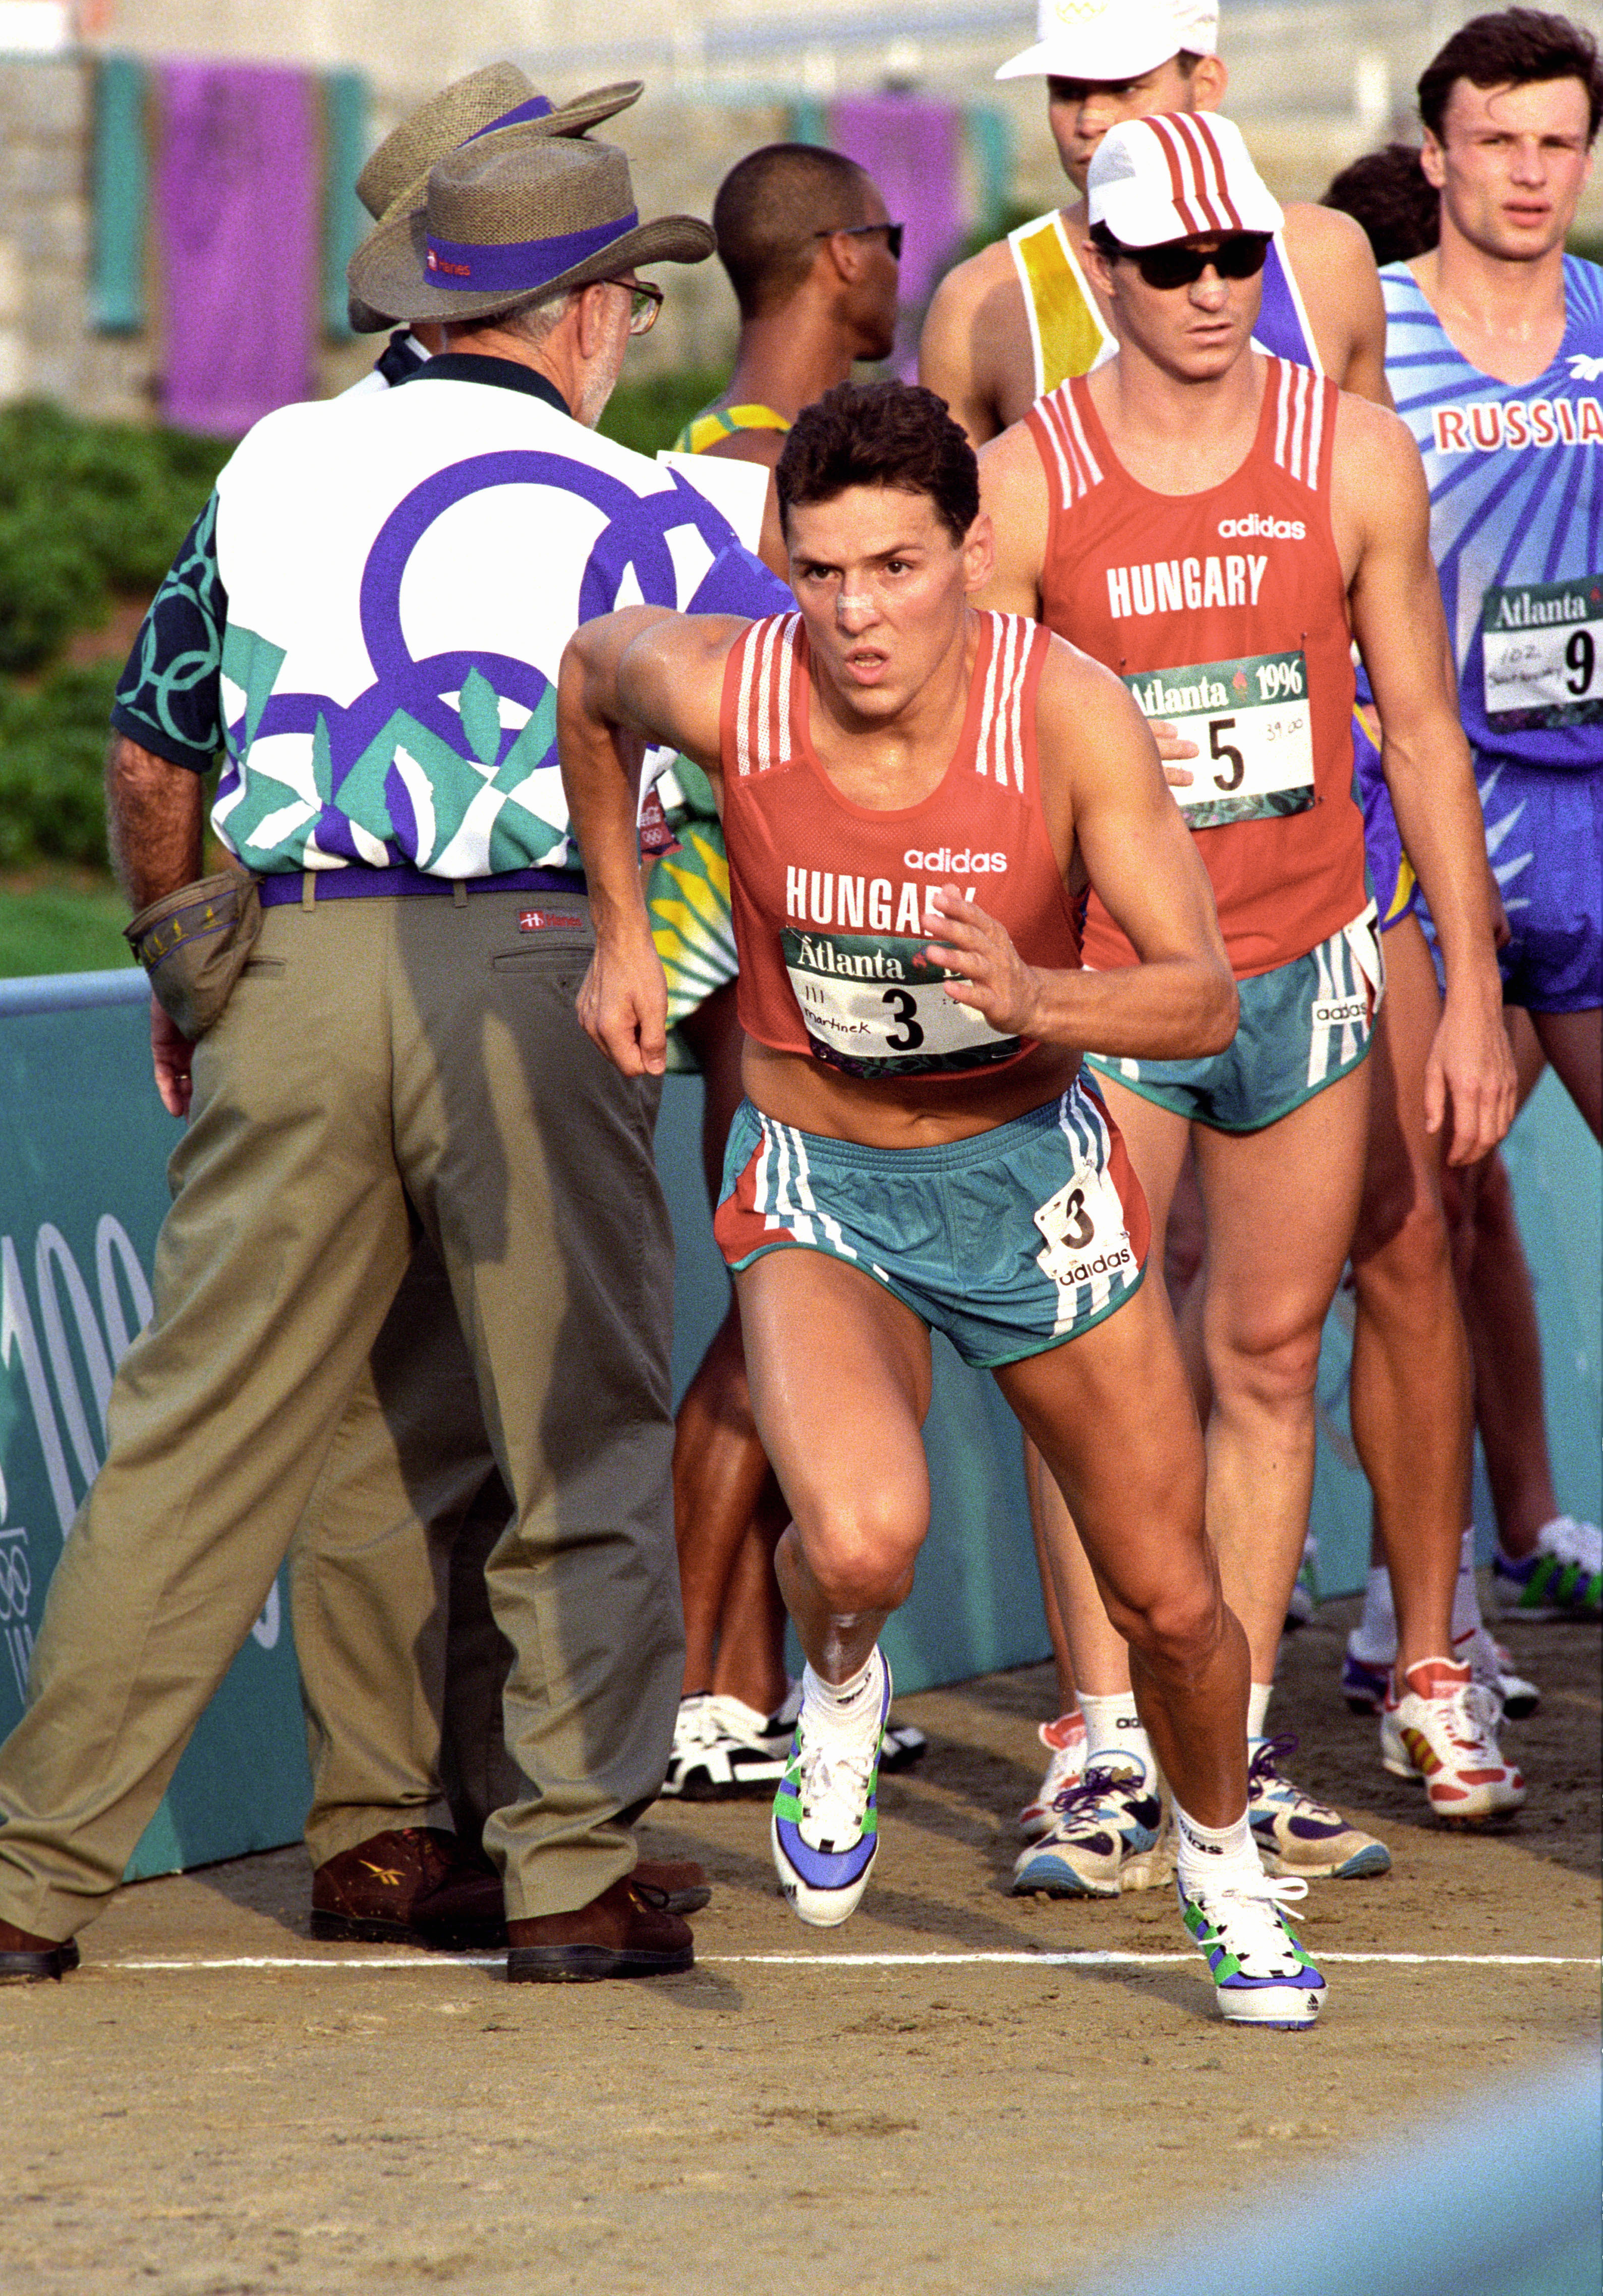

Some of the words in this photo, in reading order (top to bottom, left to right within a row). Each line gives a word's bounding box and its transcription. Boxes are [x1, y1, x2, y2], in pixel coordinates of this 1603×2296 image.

[1432, 397, 1603, 454] RUSSIA
[1218, 513, 1306, 540] adidas
[1107, 554, 1268, 619] HUNGARY
[1495, 591, 1587, 629] Atlanta
[1255, 659, 1303, 701] 1996
[1566, 630, 1596, 696] 9
[1209, 718, 1245, 792] 5
[904, 848, 1007, 873] adidas
[797, 937, 905, 980] Atlanta
[882, 988, 924, 1051] 3
[1060, 1188, 1095, 1249] 3
[1060, 1248, 1130, 1286] adidas
